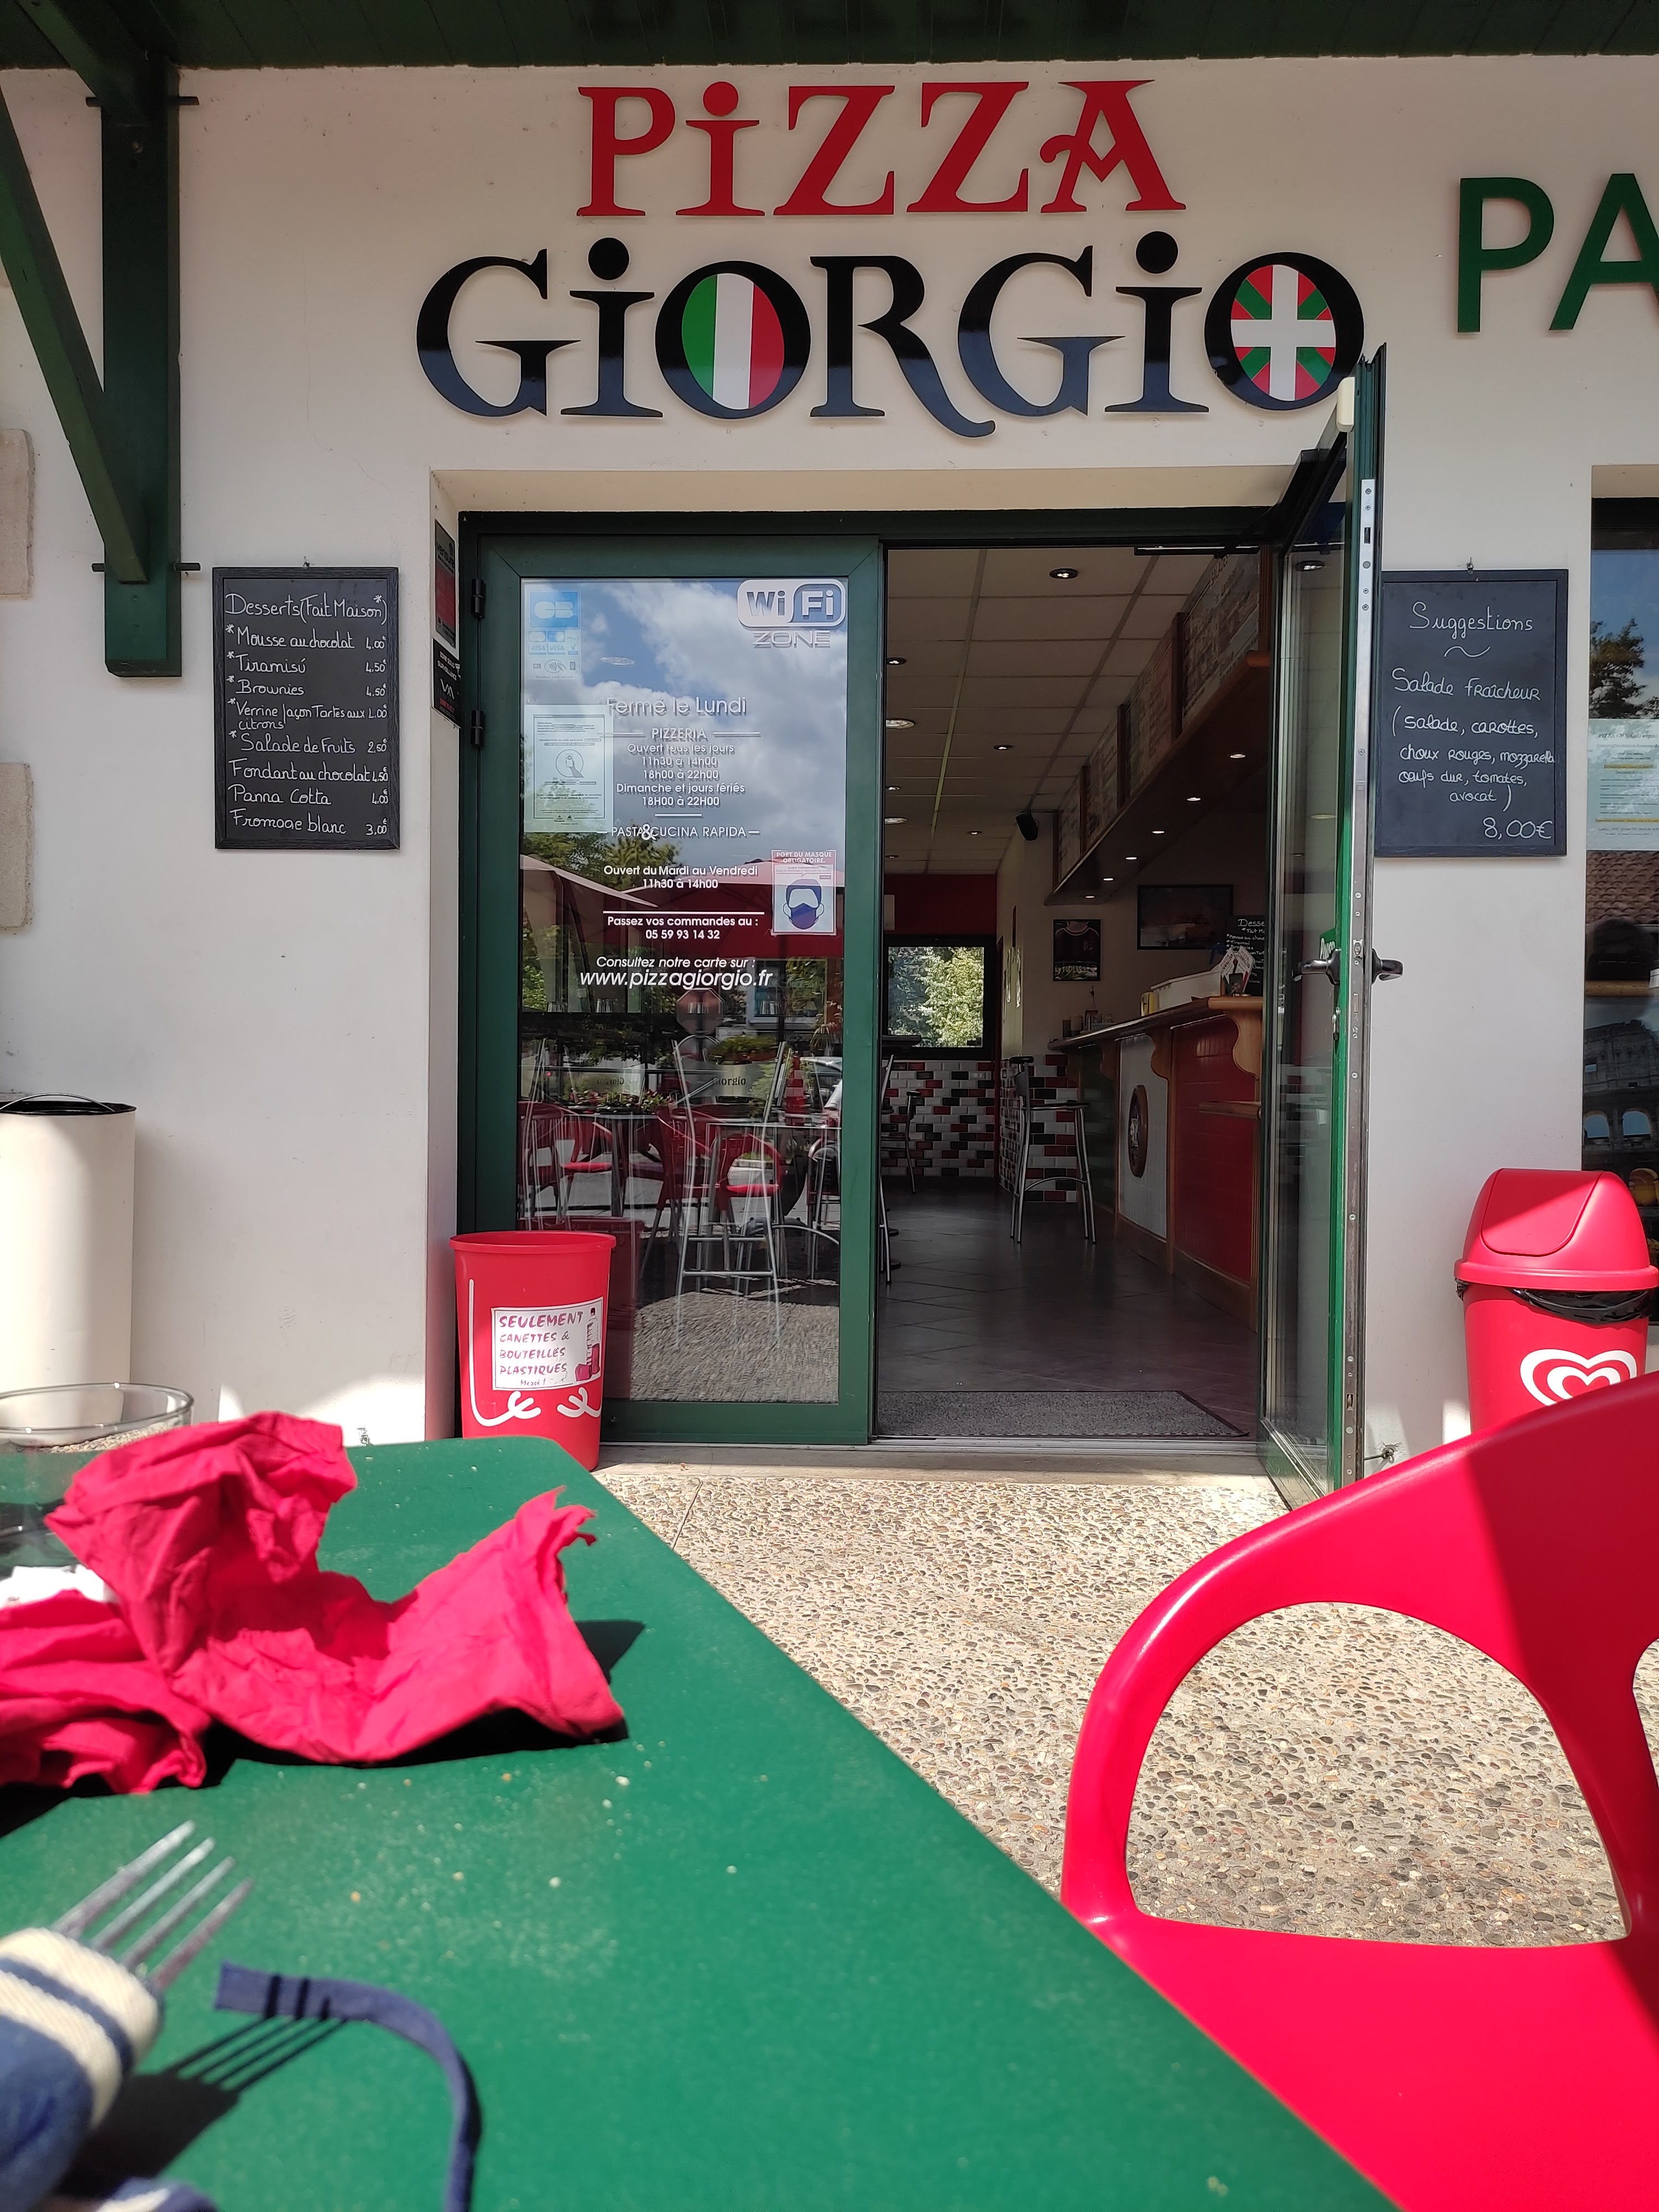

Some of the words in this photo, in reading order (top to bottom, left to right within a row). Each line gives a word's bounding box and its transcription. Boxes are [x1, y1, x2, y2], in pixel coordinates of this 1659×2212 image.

[1458, 173, 1659, 333] PA
[1410, 601, 1533, 639] Suggestions
[290, 638, 307, 648] au
[309, 628, 355, 648] chocolat
[753, 630, 830, 646] ZONE
[236, 679, 305, 695] Brownies
[1391, 667, 1454, 696] Salade
[236, 701, 278, 717] Verrine
[311, 705, 345, 718] Tartes
[347, 709, 365, 718] aux
[607, 697, 666, 714] Fermé
[673, 697, 689, 714] le
[696, 696, 747, 714] Lundi
[238, 718, 284, 731] citrons
[652, 728, 707, 739] PIZZERIA
[241, 733, 301, 752] Salade
[304, 736, 319, 753] de
[321, 737, 356, 754] Fruits
[628, 743, 664, 753] Ouvert
[666, 744, 689, 753] tous
[691, 743, 706, 753] les
[708, 743, 734, 755] jours
[1400, 743, 1439, 760] choux
[228, 758, 298, 780] Fondant
[318, 761, 370, 781] chocolat
[642, 757, 672, 766] 11h30
[676, 757, 683, 766] à
[687, 757, 718, 766] 14h00
[643, 770, 674, 779] 18h00
[677, 770, 684, 779] à
[687, 770, 719, 779] 22h00
[228, 784, 284, 803] Panna
[290, 787, 331, 805] Cotta
[617, 783, 675, 793] Dimanche
[675, 784, 685, 793] et
[688, 783, 713, 795] jours
[716, 782, 745, 793] fériés
[642, 796, 674, 806] 18H00
[677, 796, 685, 806] à
[687, 796, 719, 806] 22H00
[307, 812, 347, 834] blanc
[1483, 817, 1553, 839] 8,00€
[641, 823, 656, 840] &
[702, 826, 747, 837] RAPIDA
[603, 865, 641, 876] Ouvert
[643, 865, 657, 876] du
[659, 865, 690, 876] Mardi
[692, 868, 706, 876] au
[708, 865, 758, 876] Vendredi
[643, 879, 673, 889] 11h30
[676, 879, 685, 889] à
[687, 879, 718, 889] 14h00
[607, 916, 643, 926] Passez
[667, 916, 735, 926] commandes
[645, 930, 659, 939] 05
[661, 930, 675, 939] 59
[677, 930, 690, 939] 93
[692, 930, 706, 939] 14
[707, 930, 721, 939] 32
[596, 957, 655, 968] Consultez
[659, 958, 691, 968] notre
[694, 958, 727, 968] carte
[730, 960, 748, 968] sur
[580, 969, 773, 990] www.pizzagiorgio.fr
[499, 1311, 583, 1328] SEULEMENT
[499, 1332, 558, 1343] CANETTES
[561, 1331, 570, 1341] &
[499, 1345, 566, 1359] BOUTEILLES
[500, 1362, 567, 1376] PLASTIQUES
